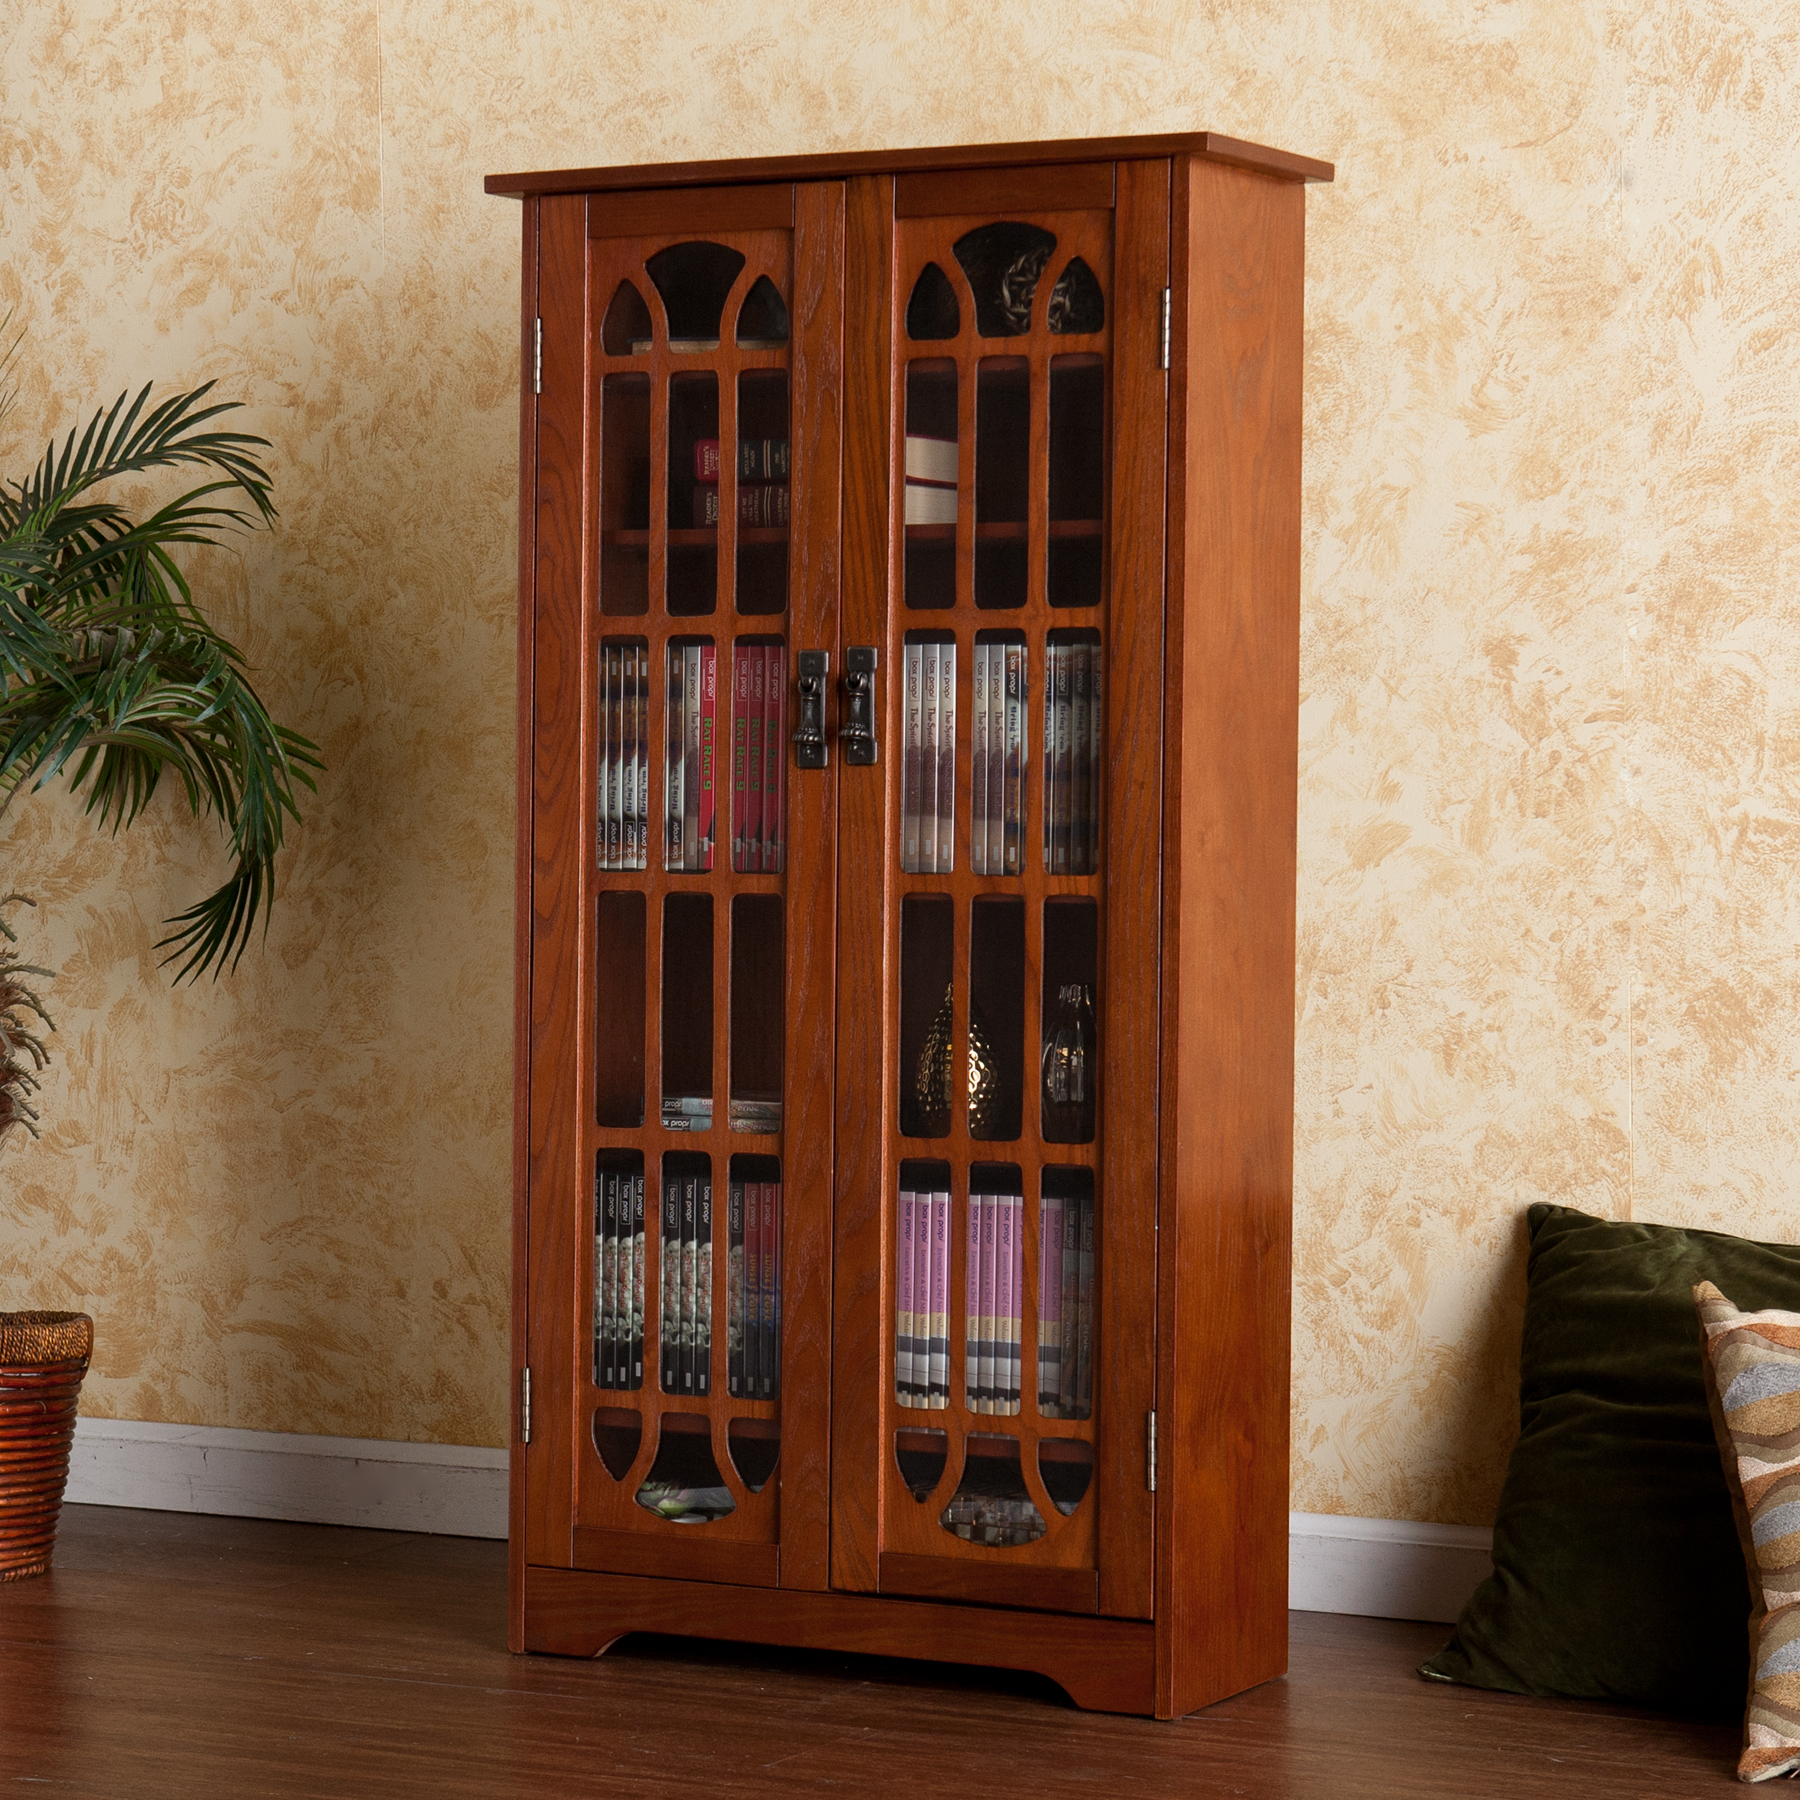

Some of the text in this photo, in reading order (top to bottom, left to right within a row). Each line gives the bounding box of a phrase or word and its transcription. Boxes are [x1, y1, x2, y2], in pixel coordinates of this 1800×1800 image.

[749, 1254, 758, 1320] SUNSET COVE
[764, 1254, 773, 1320] SUNSET COVE
